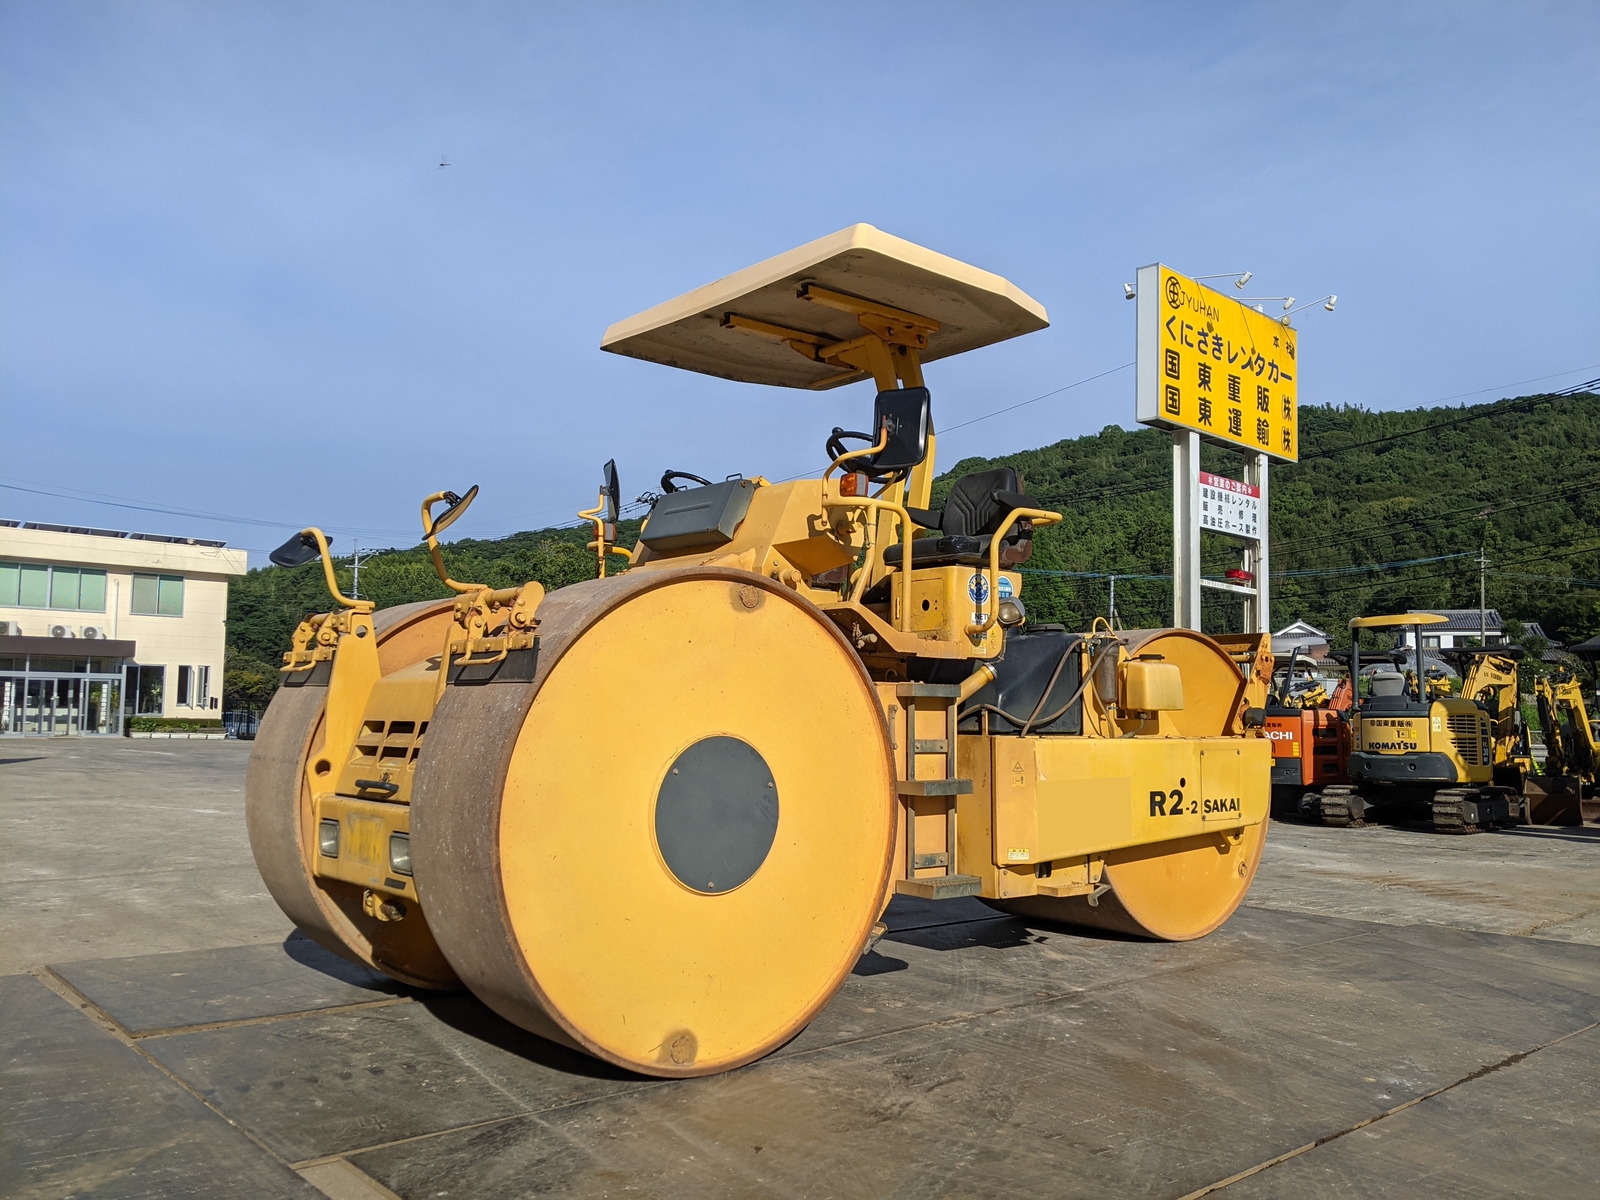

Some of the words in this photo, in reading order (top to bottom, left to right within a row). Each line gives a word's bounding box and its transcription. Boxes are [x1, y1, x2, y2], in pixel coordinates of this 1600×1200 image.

[1165, 315, 1292, 384] くにさきレンタカー
[1368, 740, 1417, 750] KOMATSU
[1203, 798, 1240, 814] SAKAI
